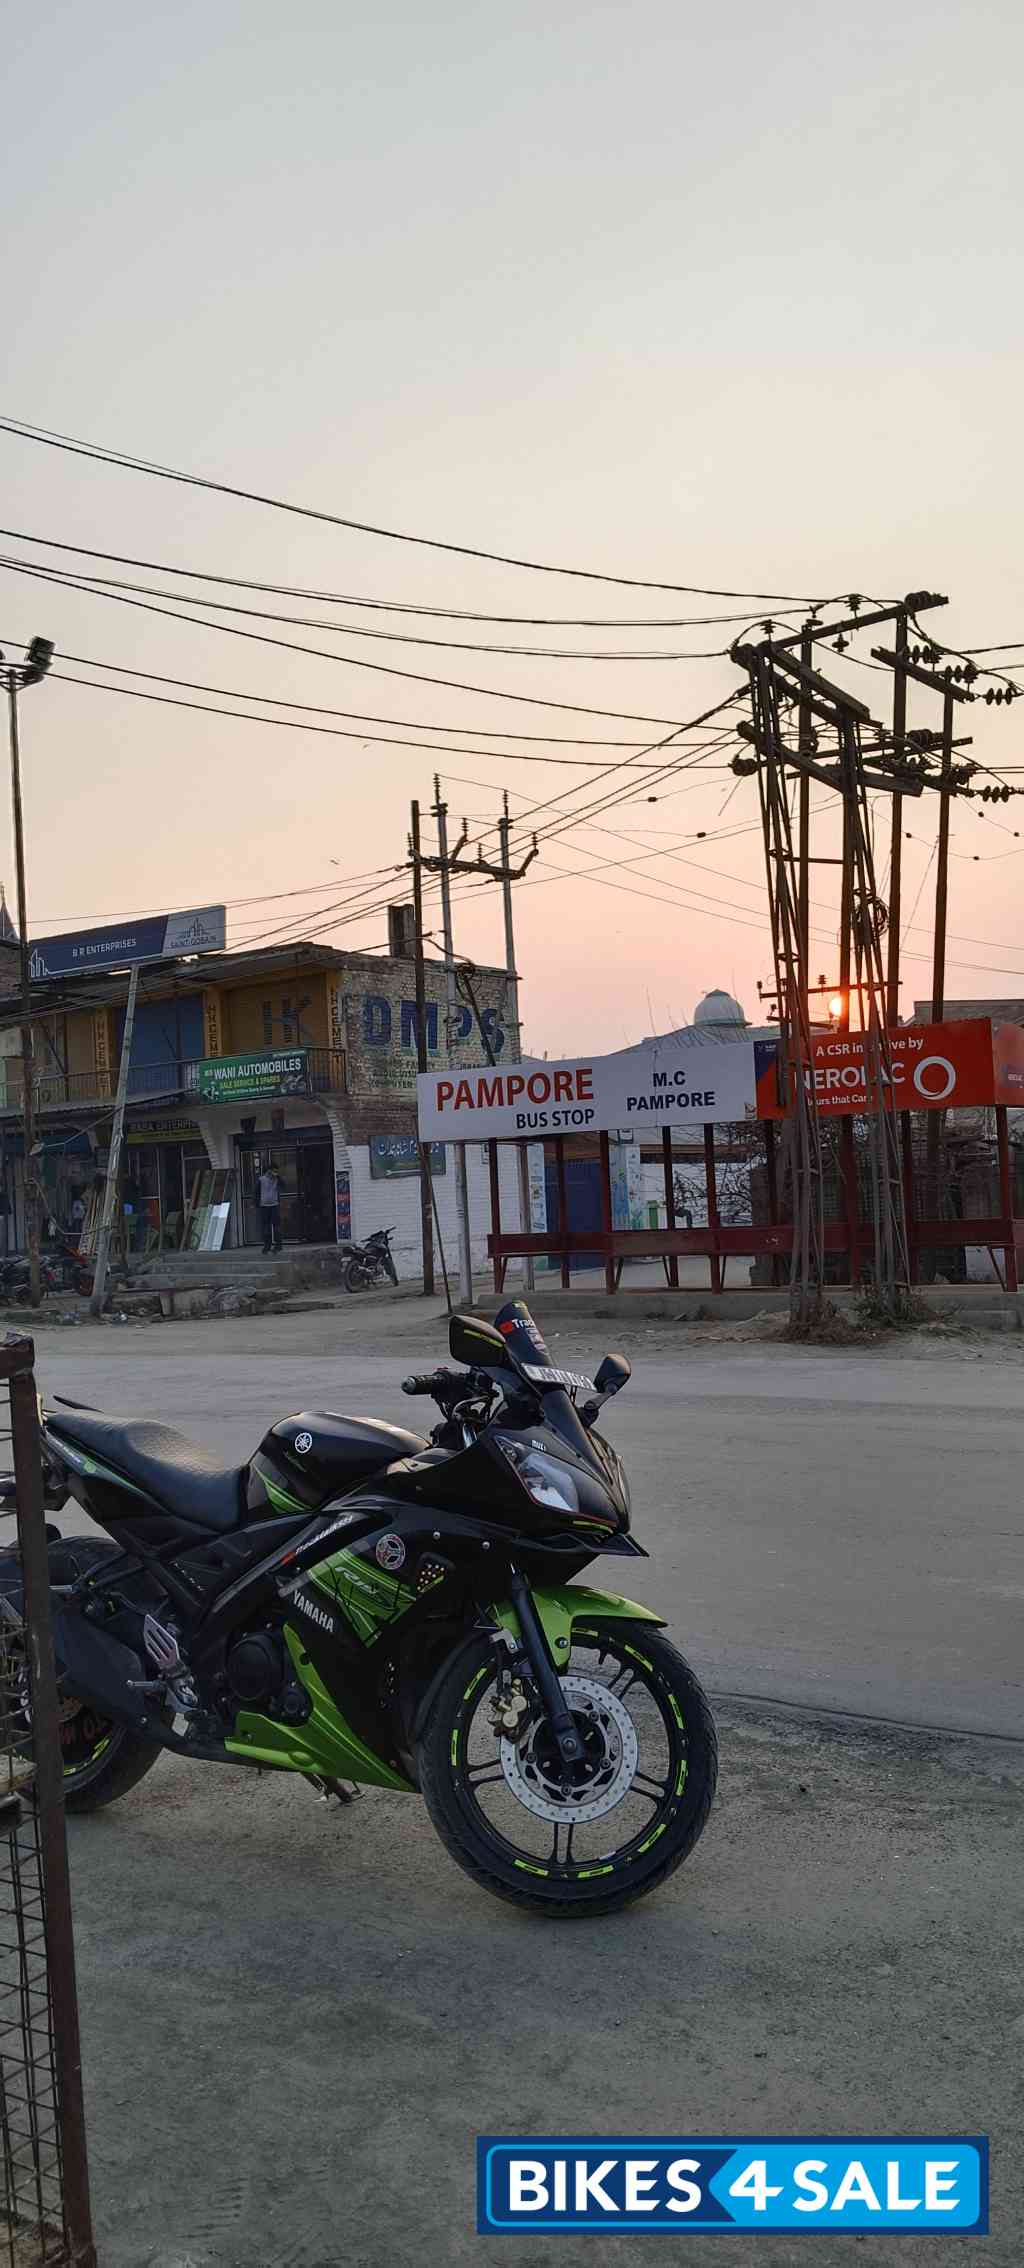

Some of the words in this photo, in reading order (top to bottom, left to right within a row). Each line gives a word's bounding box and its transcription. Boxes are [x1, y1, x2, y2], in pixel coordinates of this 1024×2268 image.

[86, 938, 137, 955] ENTERPRISES
[816, 1046, 825, 1057] A
[827, 1043, 851, 1056] CSR
[908, 1037, 924, 1050] by
[214, 1067, 236, 1080] WANI
[238, 1058, 302, 1077] AUTOMOBILES
[652, 1070, 686, 1088] M.C
[436, 1068, 594, 1112] PAMPORE
[832, 1095, 851, 1105] that
[627, 1091, 716, 1112] PAMPORE
[516, 1111, 548, 1129] BUS
[552, 1108, 595, 1127] STOP
[293, 1589, 334, 1633] YAMAHA
